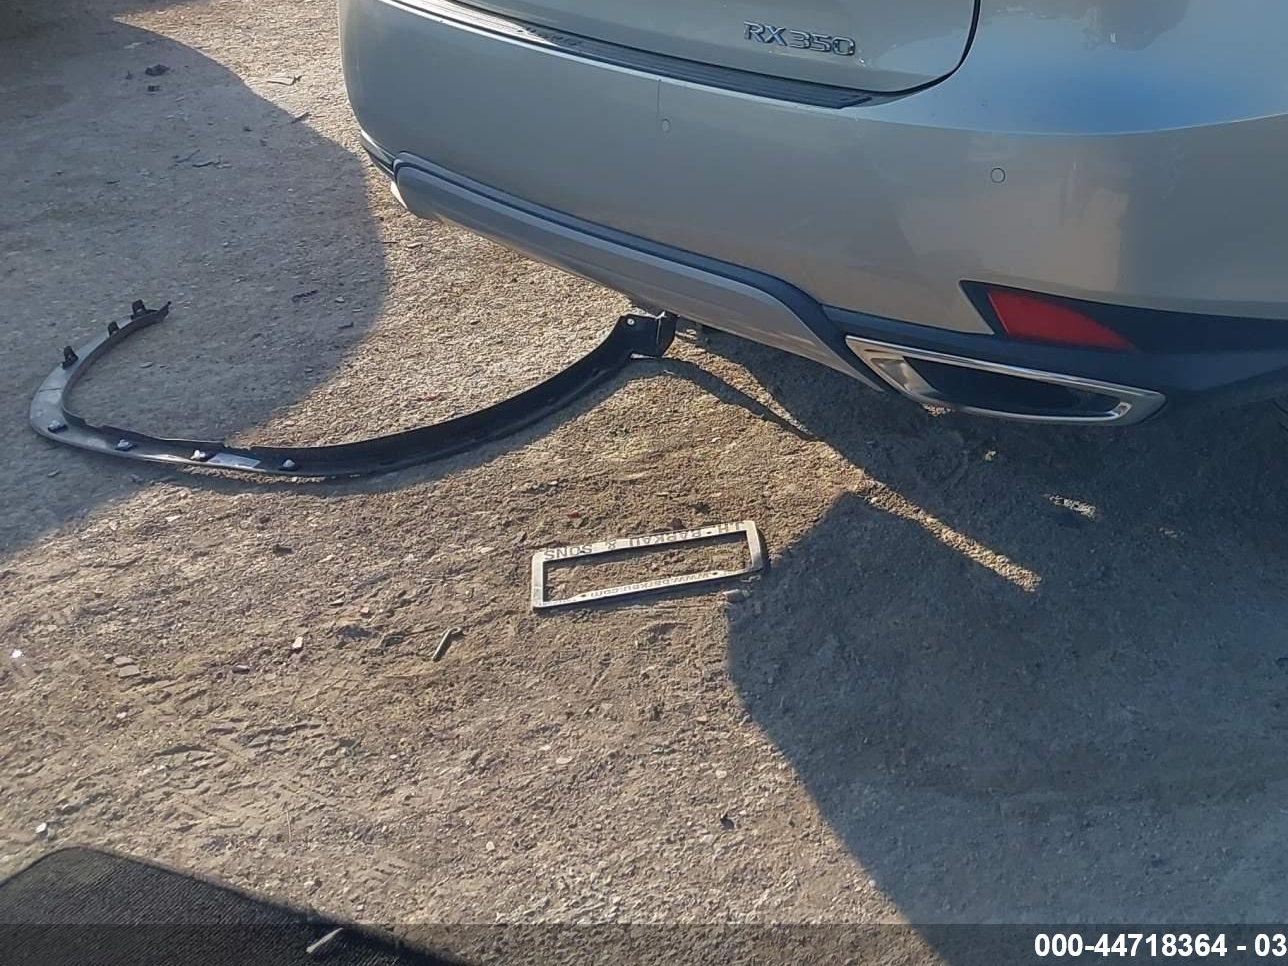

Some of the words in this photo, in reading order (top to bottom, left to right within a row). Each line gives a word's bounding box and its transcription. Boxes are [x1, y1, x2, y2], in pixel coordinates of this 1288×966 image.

[743, 20, 787, 47] RX
[789, 29, 856, 56] 350
[543, 544, 593, 561] SONS
